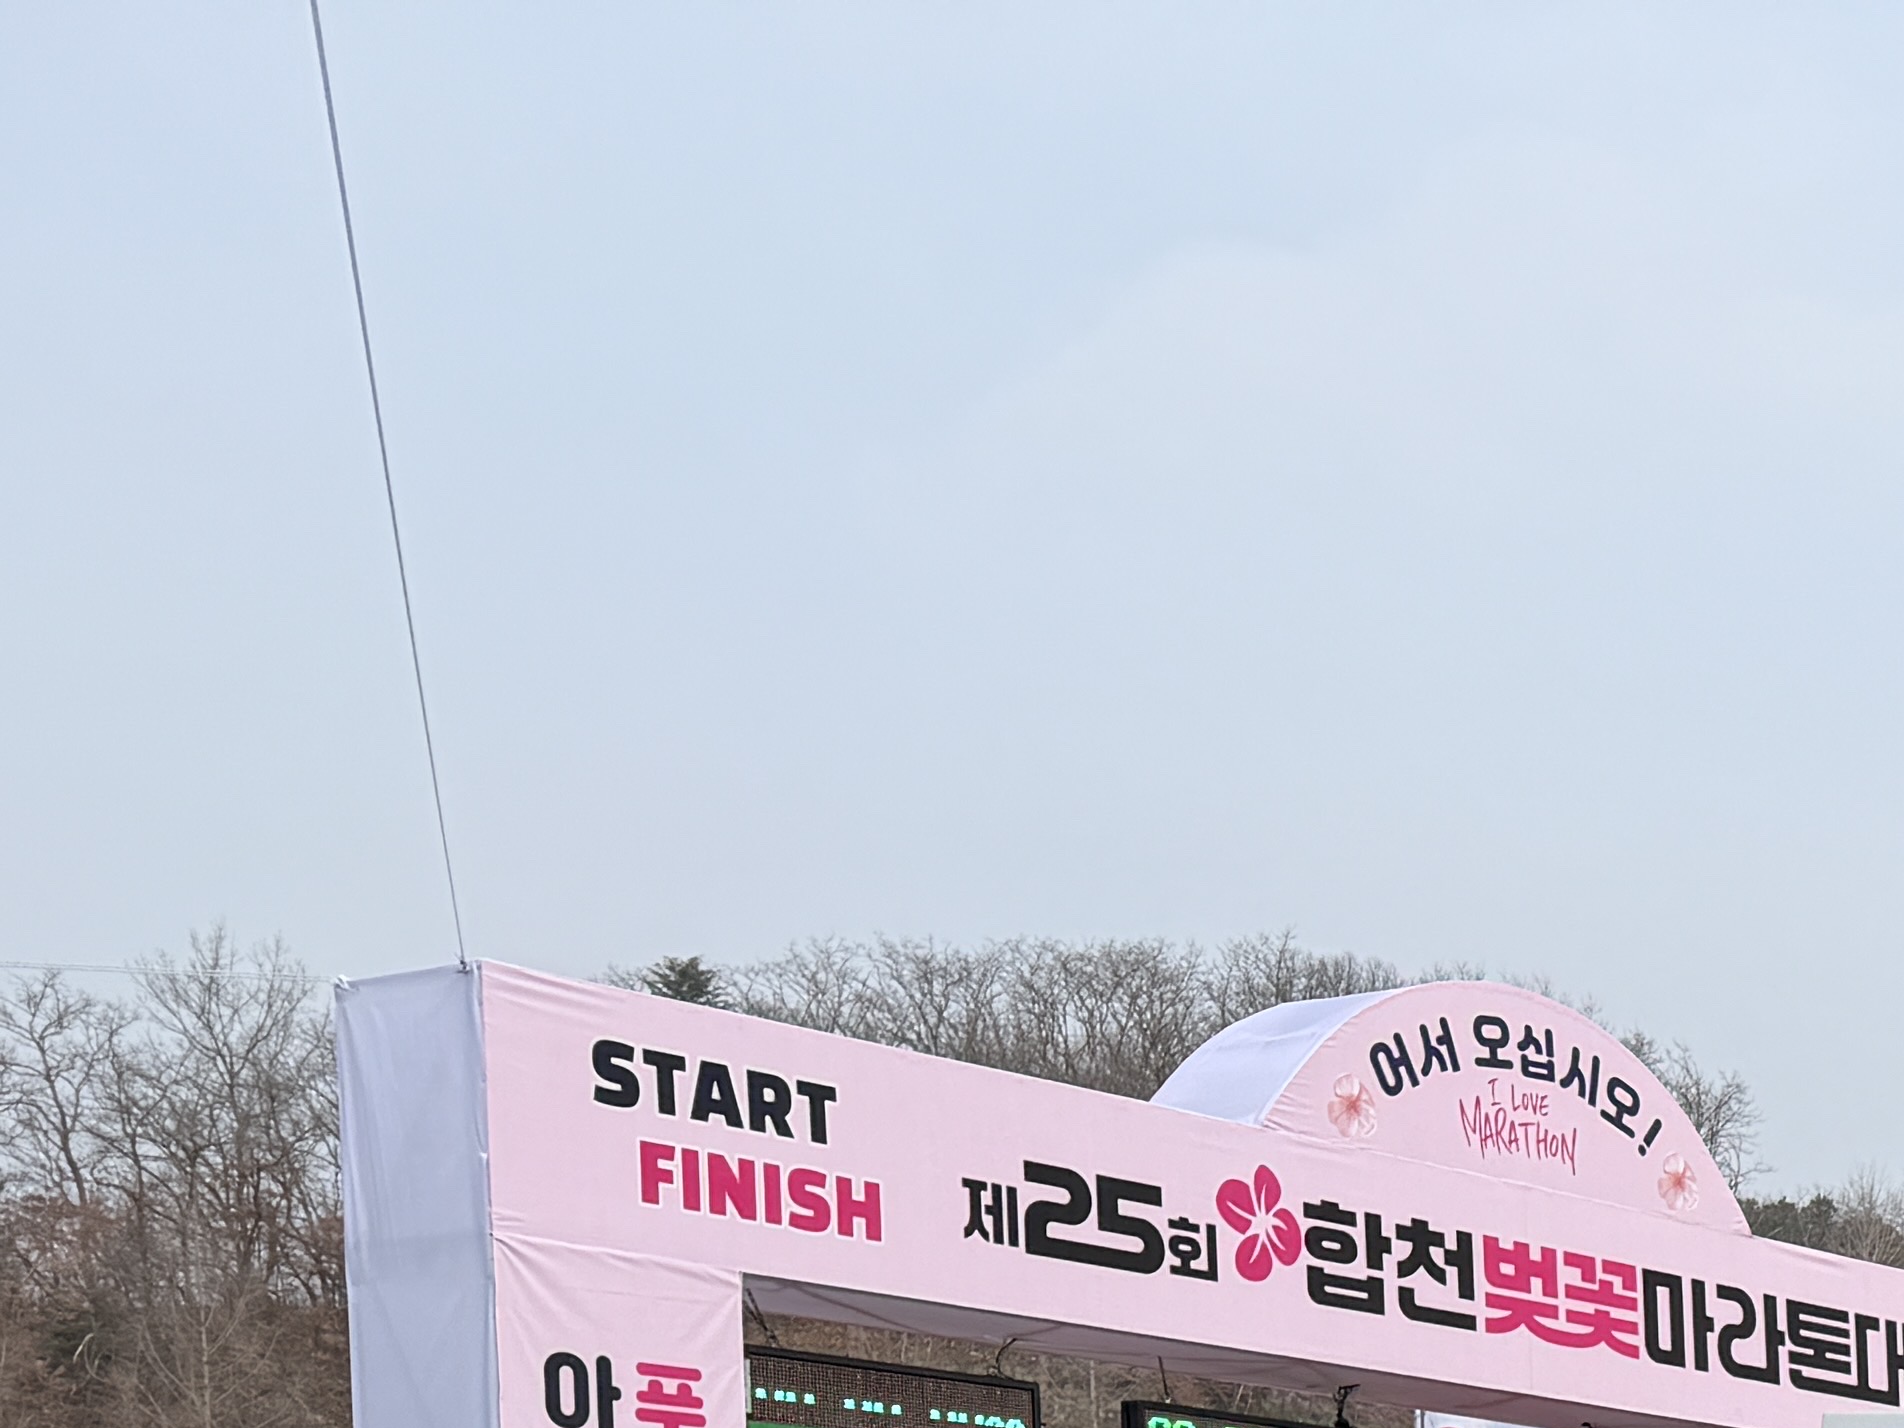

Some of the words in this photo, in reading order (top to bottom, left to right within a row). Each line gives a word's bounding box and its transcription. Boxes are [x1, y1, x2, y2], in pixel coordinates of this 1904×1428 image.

[591, 1038, 838, 1147] START
[1369, 1015, 1460, 1097] 어서
[1473, 1014, 1664, 1158] 오십시오!
[1459, 1096, 1577, 1175] MARATHON
[1488, 1079, 1500, 1109] I
[1511, 1083, 1549, 1118] LOVE
[638, 1138, 884, 1244] FINISH
[961, 1160, 1219, 1283] 제25회
